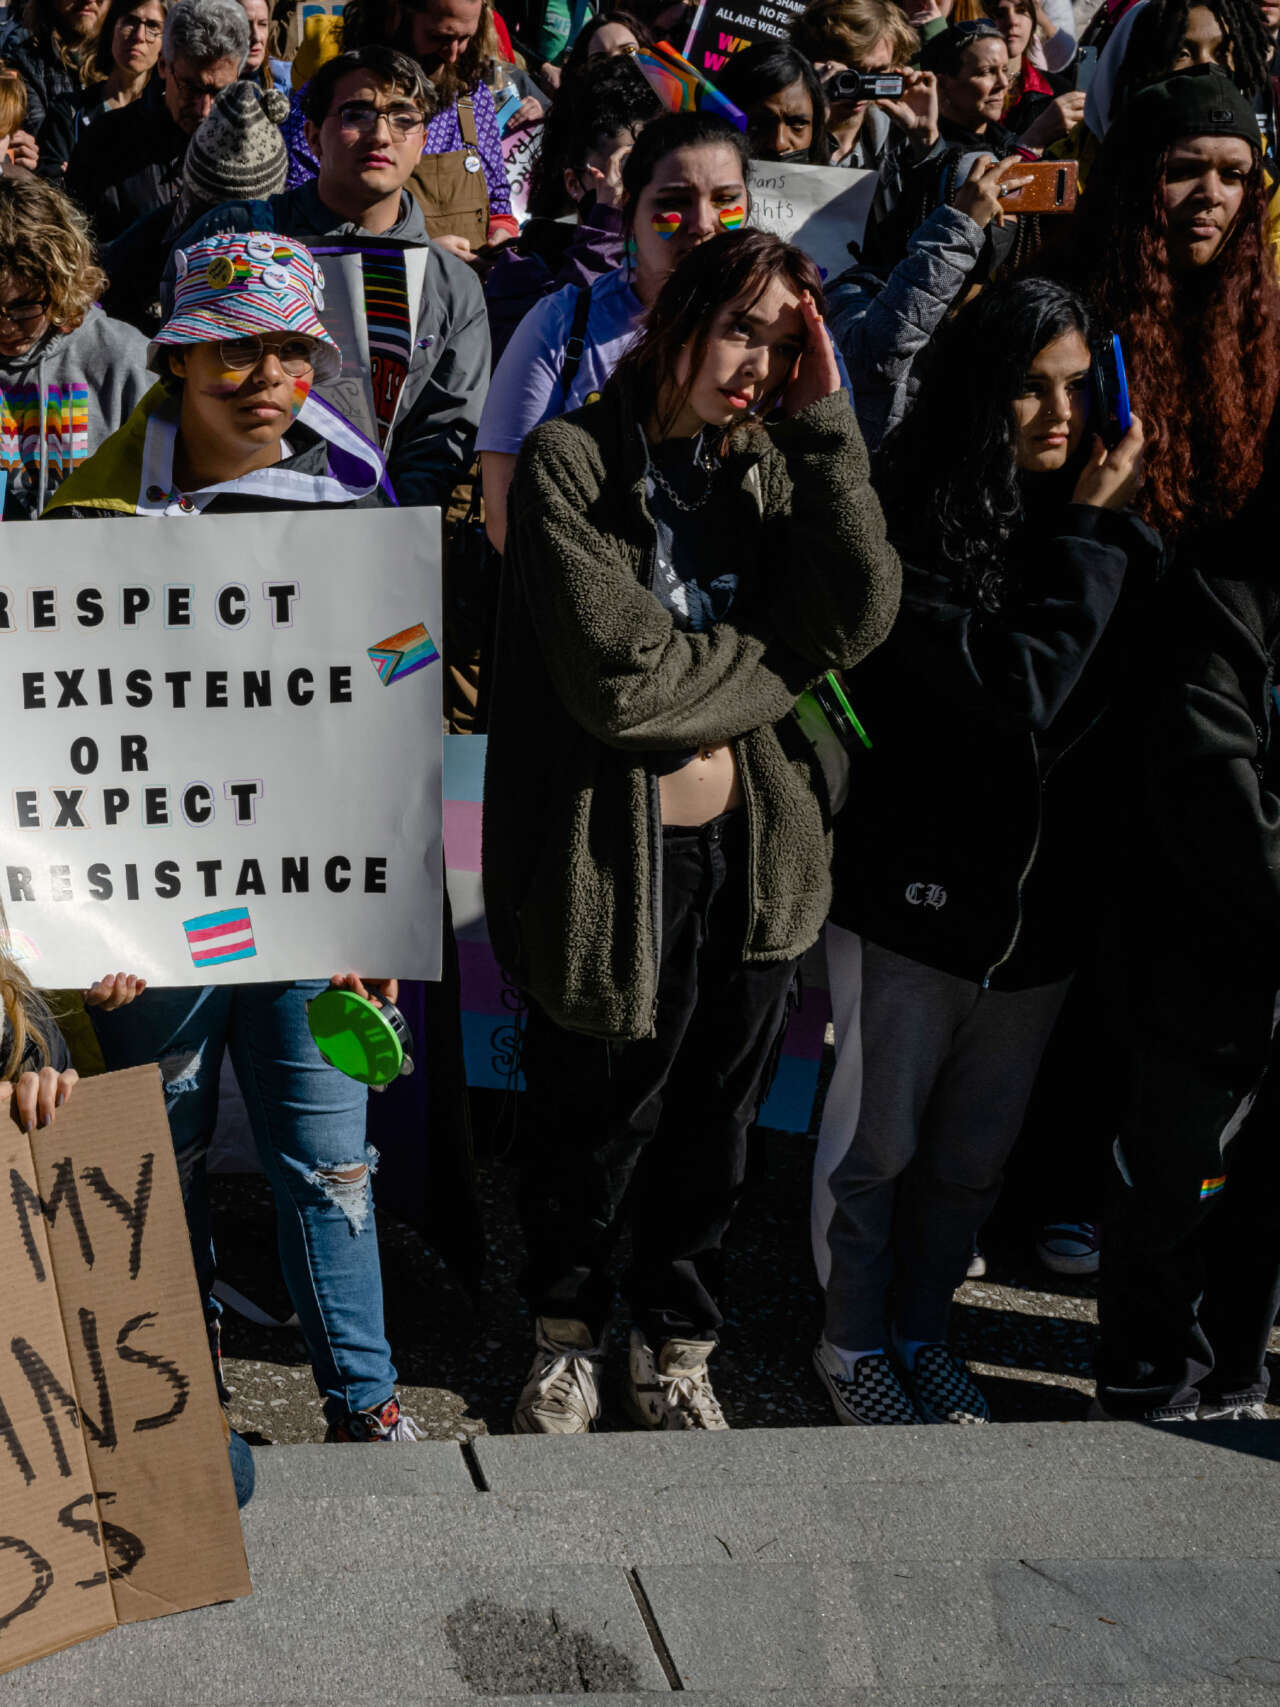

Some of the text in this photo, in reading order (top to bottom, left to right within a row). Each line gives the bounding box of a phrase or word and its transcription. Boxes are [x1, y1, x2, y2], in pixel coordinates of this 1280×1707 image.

[716, 8, 734, 21] ALL
[734, 14, 758, 29] ARE
[758, 5, 776, 18] NO
[22, 666, 353, 710] EXISTENCE
[70, 734, 149, 775] OR
[16, 782, 261, 829] EXPECT
[6, 857, 387, 902] RESISTANCE
[10, 1153, 156, 1283] MY
